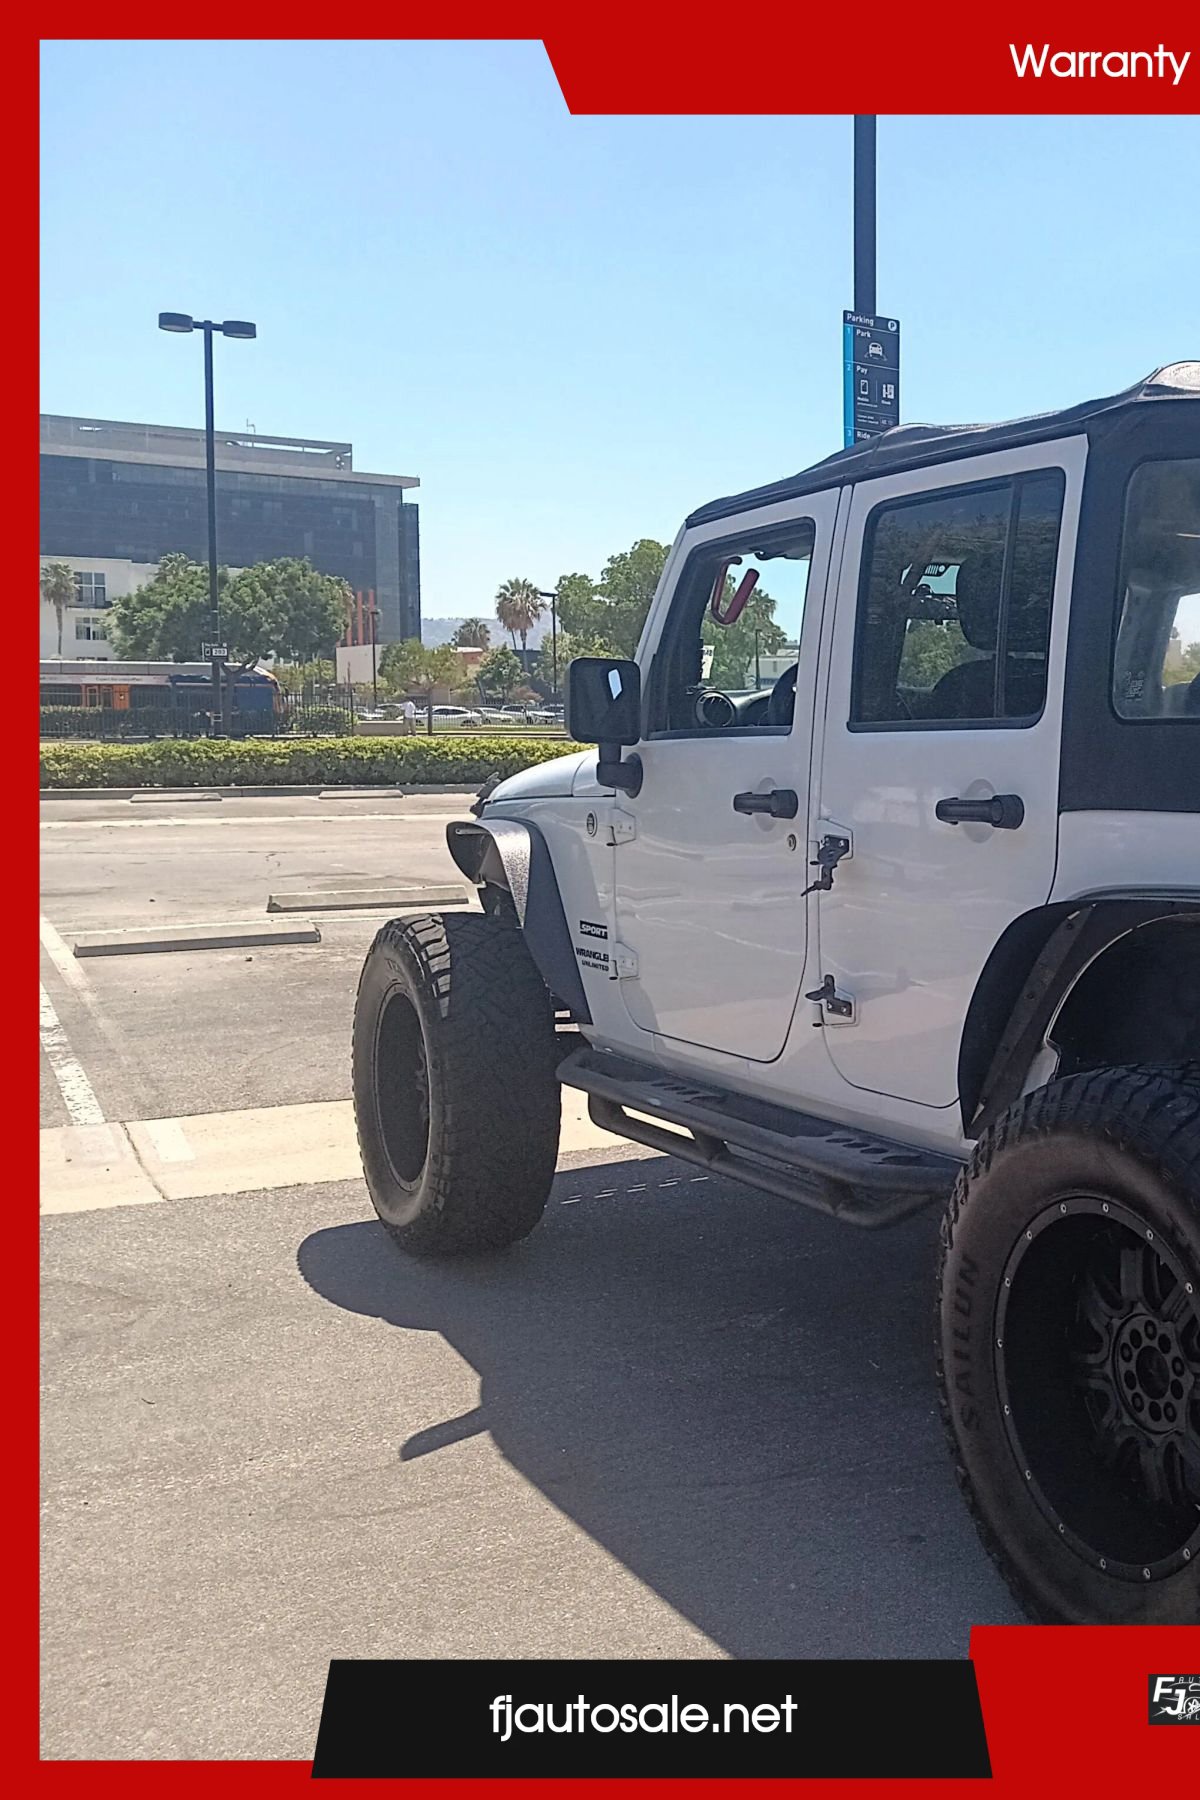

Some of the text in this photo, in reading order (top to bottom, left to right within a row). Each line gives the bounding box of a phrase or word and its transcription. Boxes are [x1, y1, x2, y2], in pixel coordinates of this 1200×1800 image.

[846, 312, 875, 327] Parking
[856, 329, 872, 338] Park
[856, 365, 868, 375] Pay
[856, 430, 871, 440] Ride
[581, 923, 607, 937] SPORT
[581, 959, 609, 972] UNLIMITED
[953, 1252, 981, 1431] SAILUN
